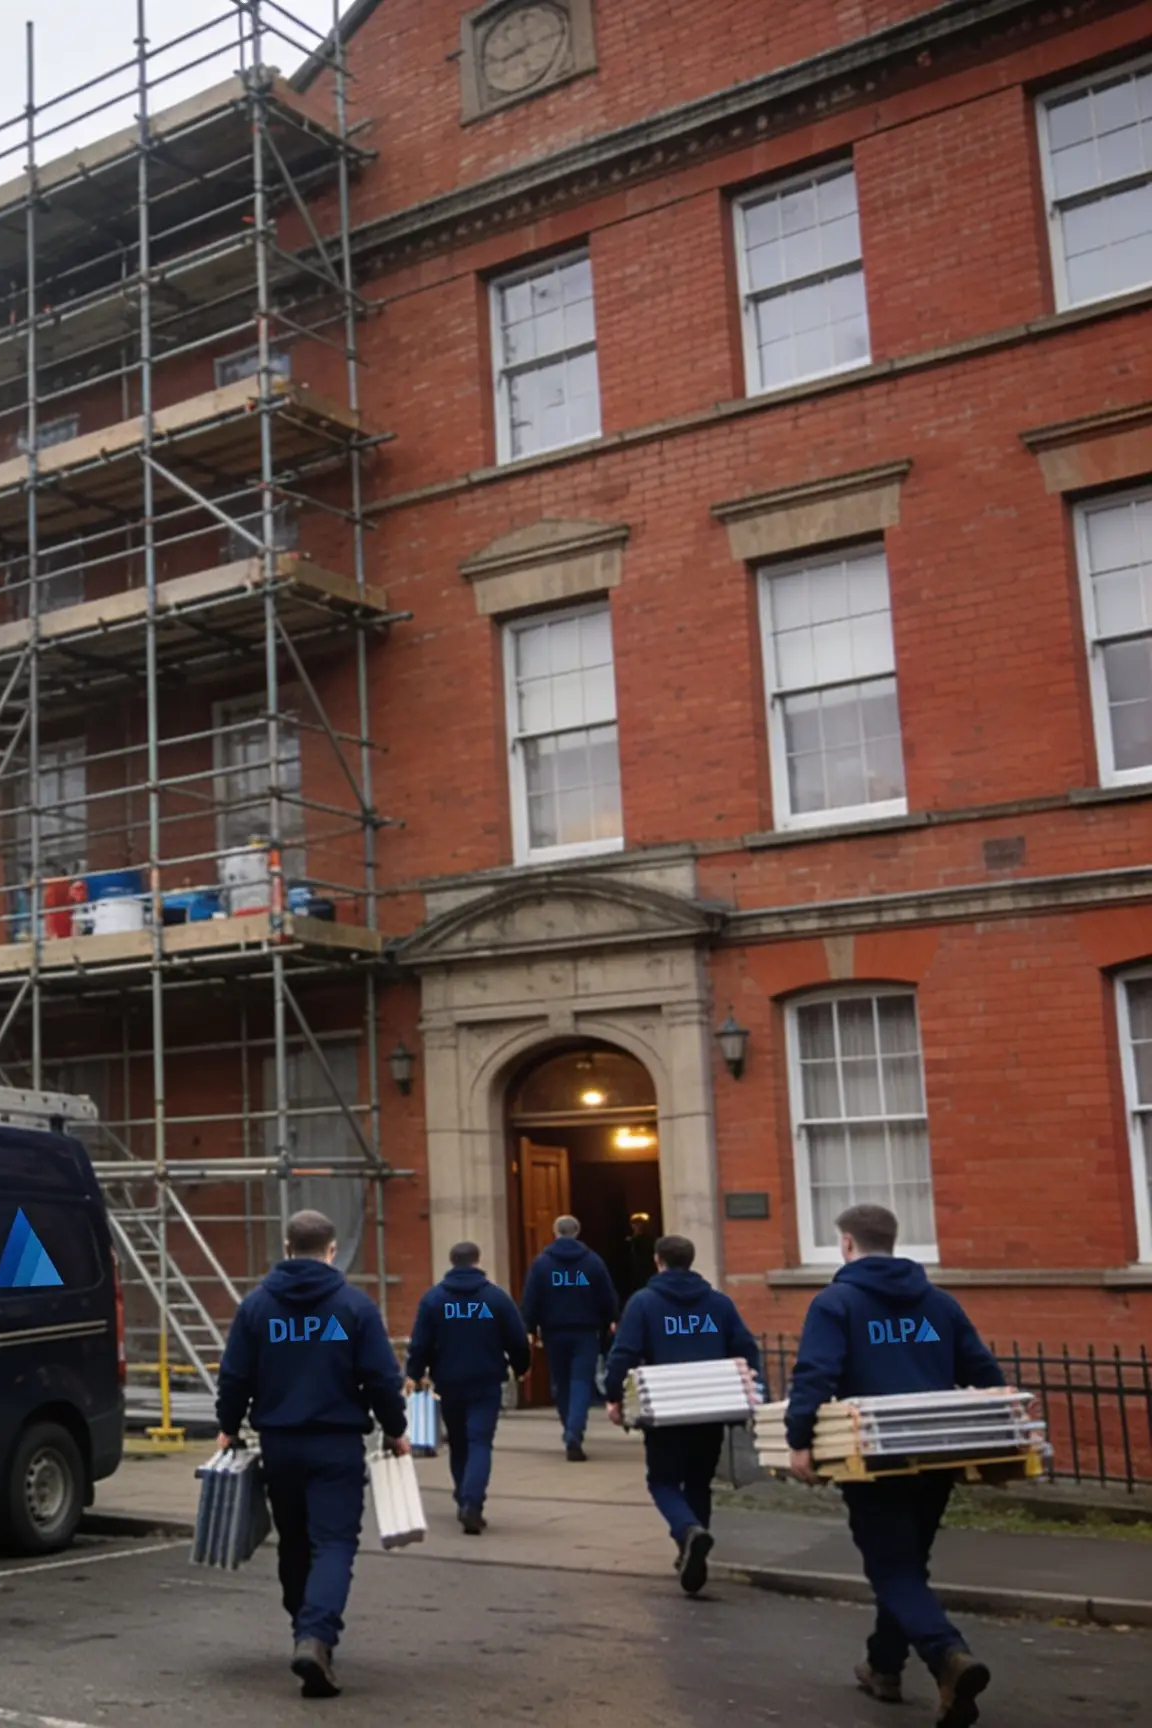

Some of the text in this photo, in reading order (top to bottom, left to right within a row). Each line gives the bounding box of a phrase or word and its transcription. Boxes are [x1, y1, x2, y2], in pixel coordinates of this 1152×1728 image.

[444, 1303, 479, 1319] DLP
[269, 1316, 321, 1342] DLP
[664, 1314, 700, 1335] DLP
[868, 1318, 915, 1344] DLP
